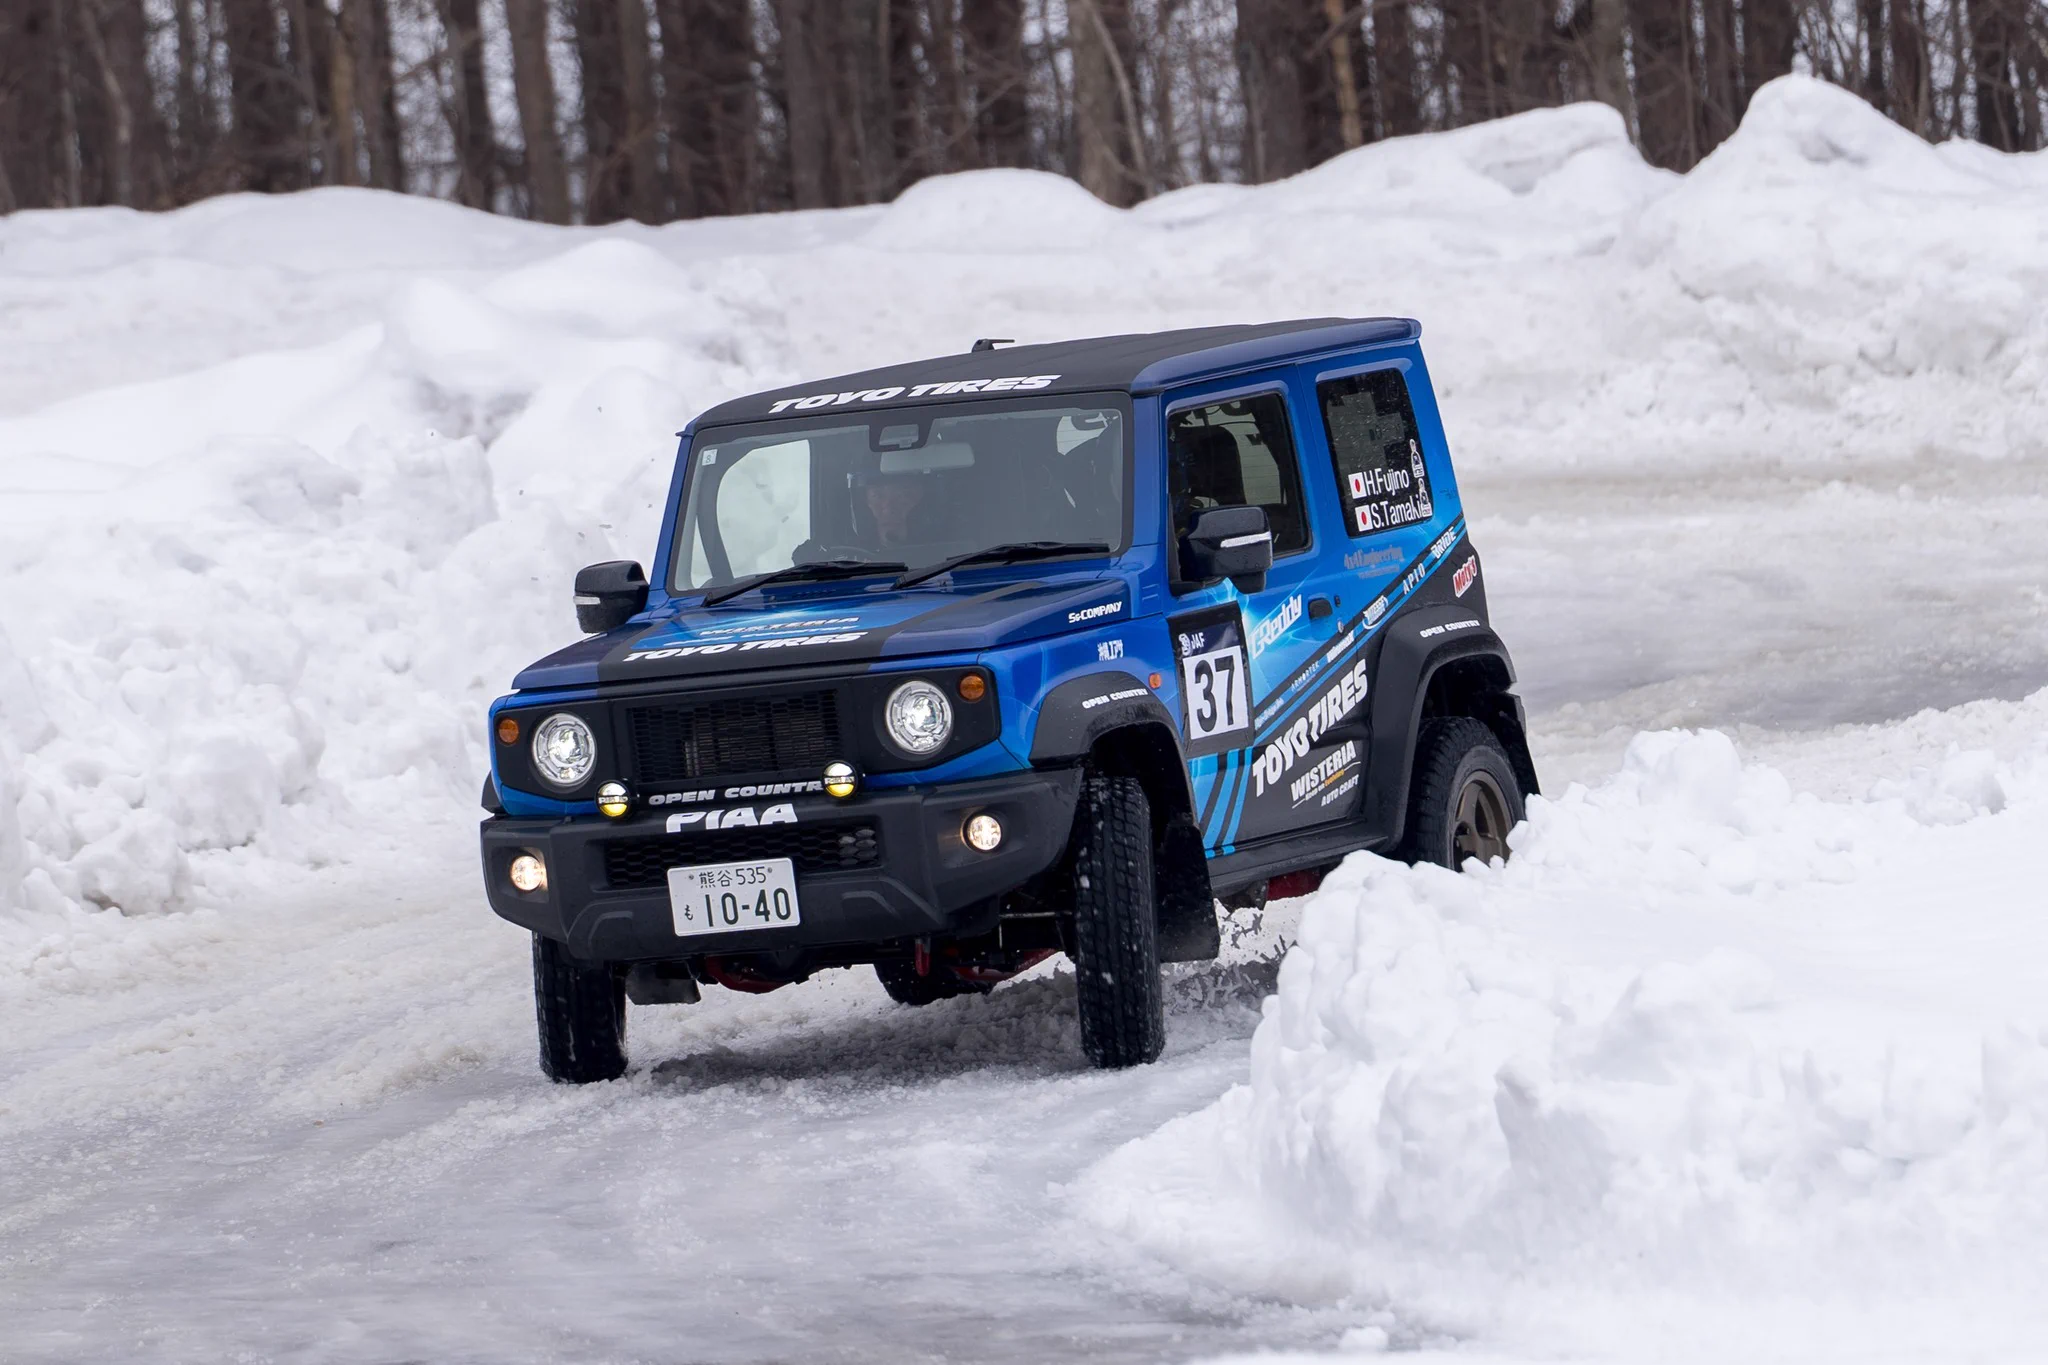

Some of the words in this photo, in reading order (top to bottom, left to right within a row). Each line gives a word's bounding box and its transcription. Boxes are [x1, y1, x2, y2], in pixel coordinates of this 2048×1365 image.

[768, 387, 906, 414] TOYO
[907, 375, 1062, 398] TIRES
[1363, 467, 1410, 497] H.Fujino
[1370, 494, 1422, 529] S.Tamaki
[1191, 632, 1206, 650] JAF
[1249, 594, 1303, 660] GReddy
[1419, 625, 1446, 638] OPEN
[1444, 619, 1480, 631] COUNTRY
[622, 643, 738, 662] TOYO
[739, 631, 869, 651] TIRES
[1082, 694, 1110, 709] OPEN
[1110, 688, 1149, 701] COUNTRY
[1194, 654, 1235, 733] 37
[1252, 717, 1310, 798] TOYO
[1308, 658, 1368, 742] TIRES
[1290, 740, 1357, 801] WISTERIA
[648, 789, 716, 805] OPEN
[724, 780, 824, 798] COUNTR
[666, 803, 798, 833] PIAA
[684, 904, 694, 921] も
[705, 887, 792, 928] 10-40
